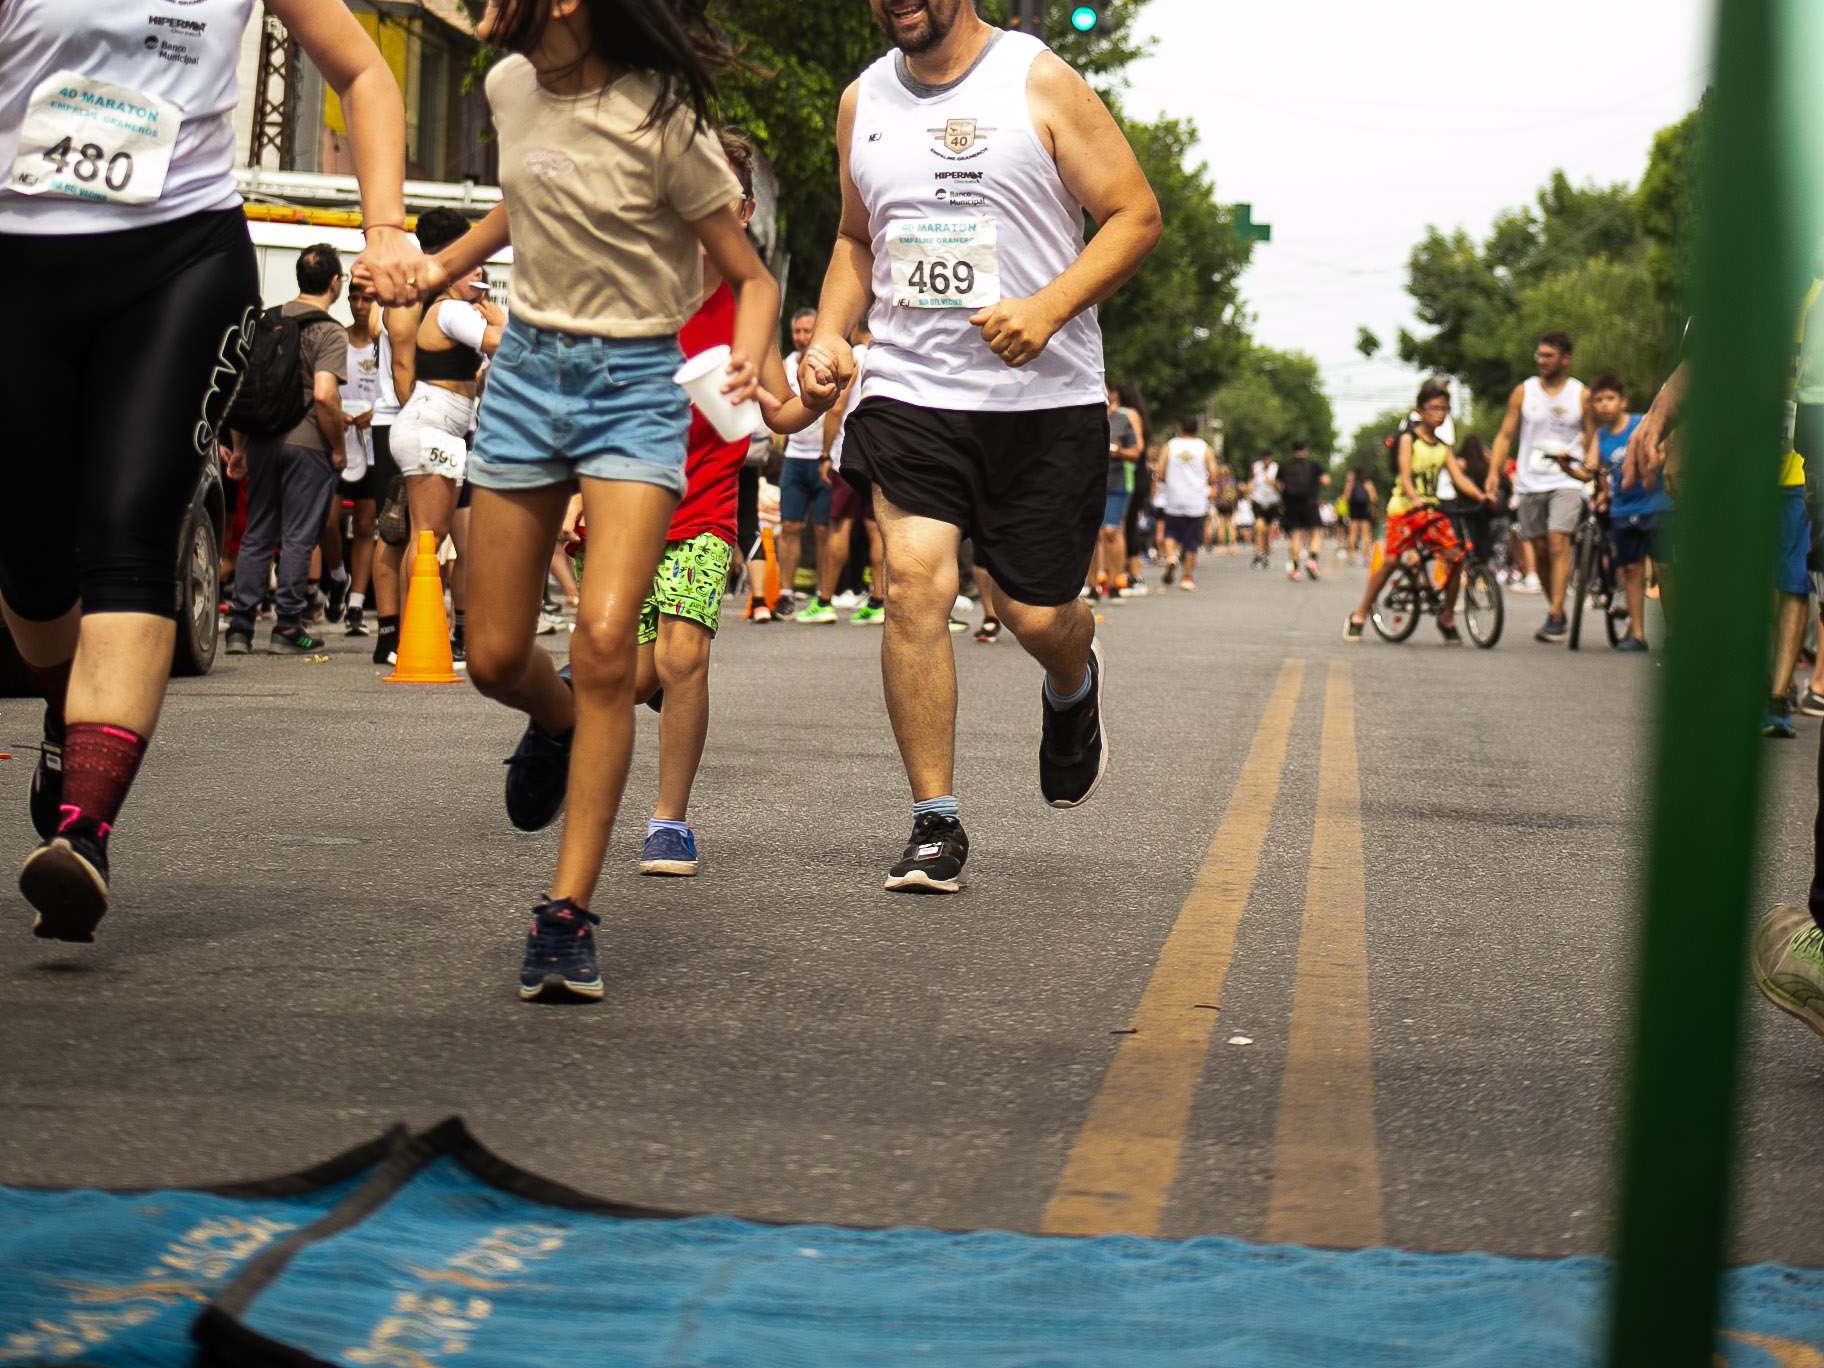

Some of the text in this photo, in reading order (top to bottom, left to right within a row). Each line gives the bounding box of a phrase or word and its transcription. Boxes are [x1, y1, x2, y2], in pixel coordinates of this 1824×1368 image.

[161, 41, 187, 53] Banco
[159, 51, 200, 65] Municipal
[59, 87, 159, 122] 40 MARATON
[951, 136, 968, 146] 40
[43, 136, 133, 191] 480
[949, 197, 986, 207] Municipal
[902, 223, 977, 232] 40 MARATON
[908, 260, 975, 295] 469
